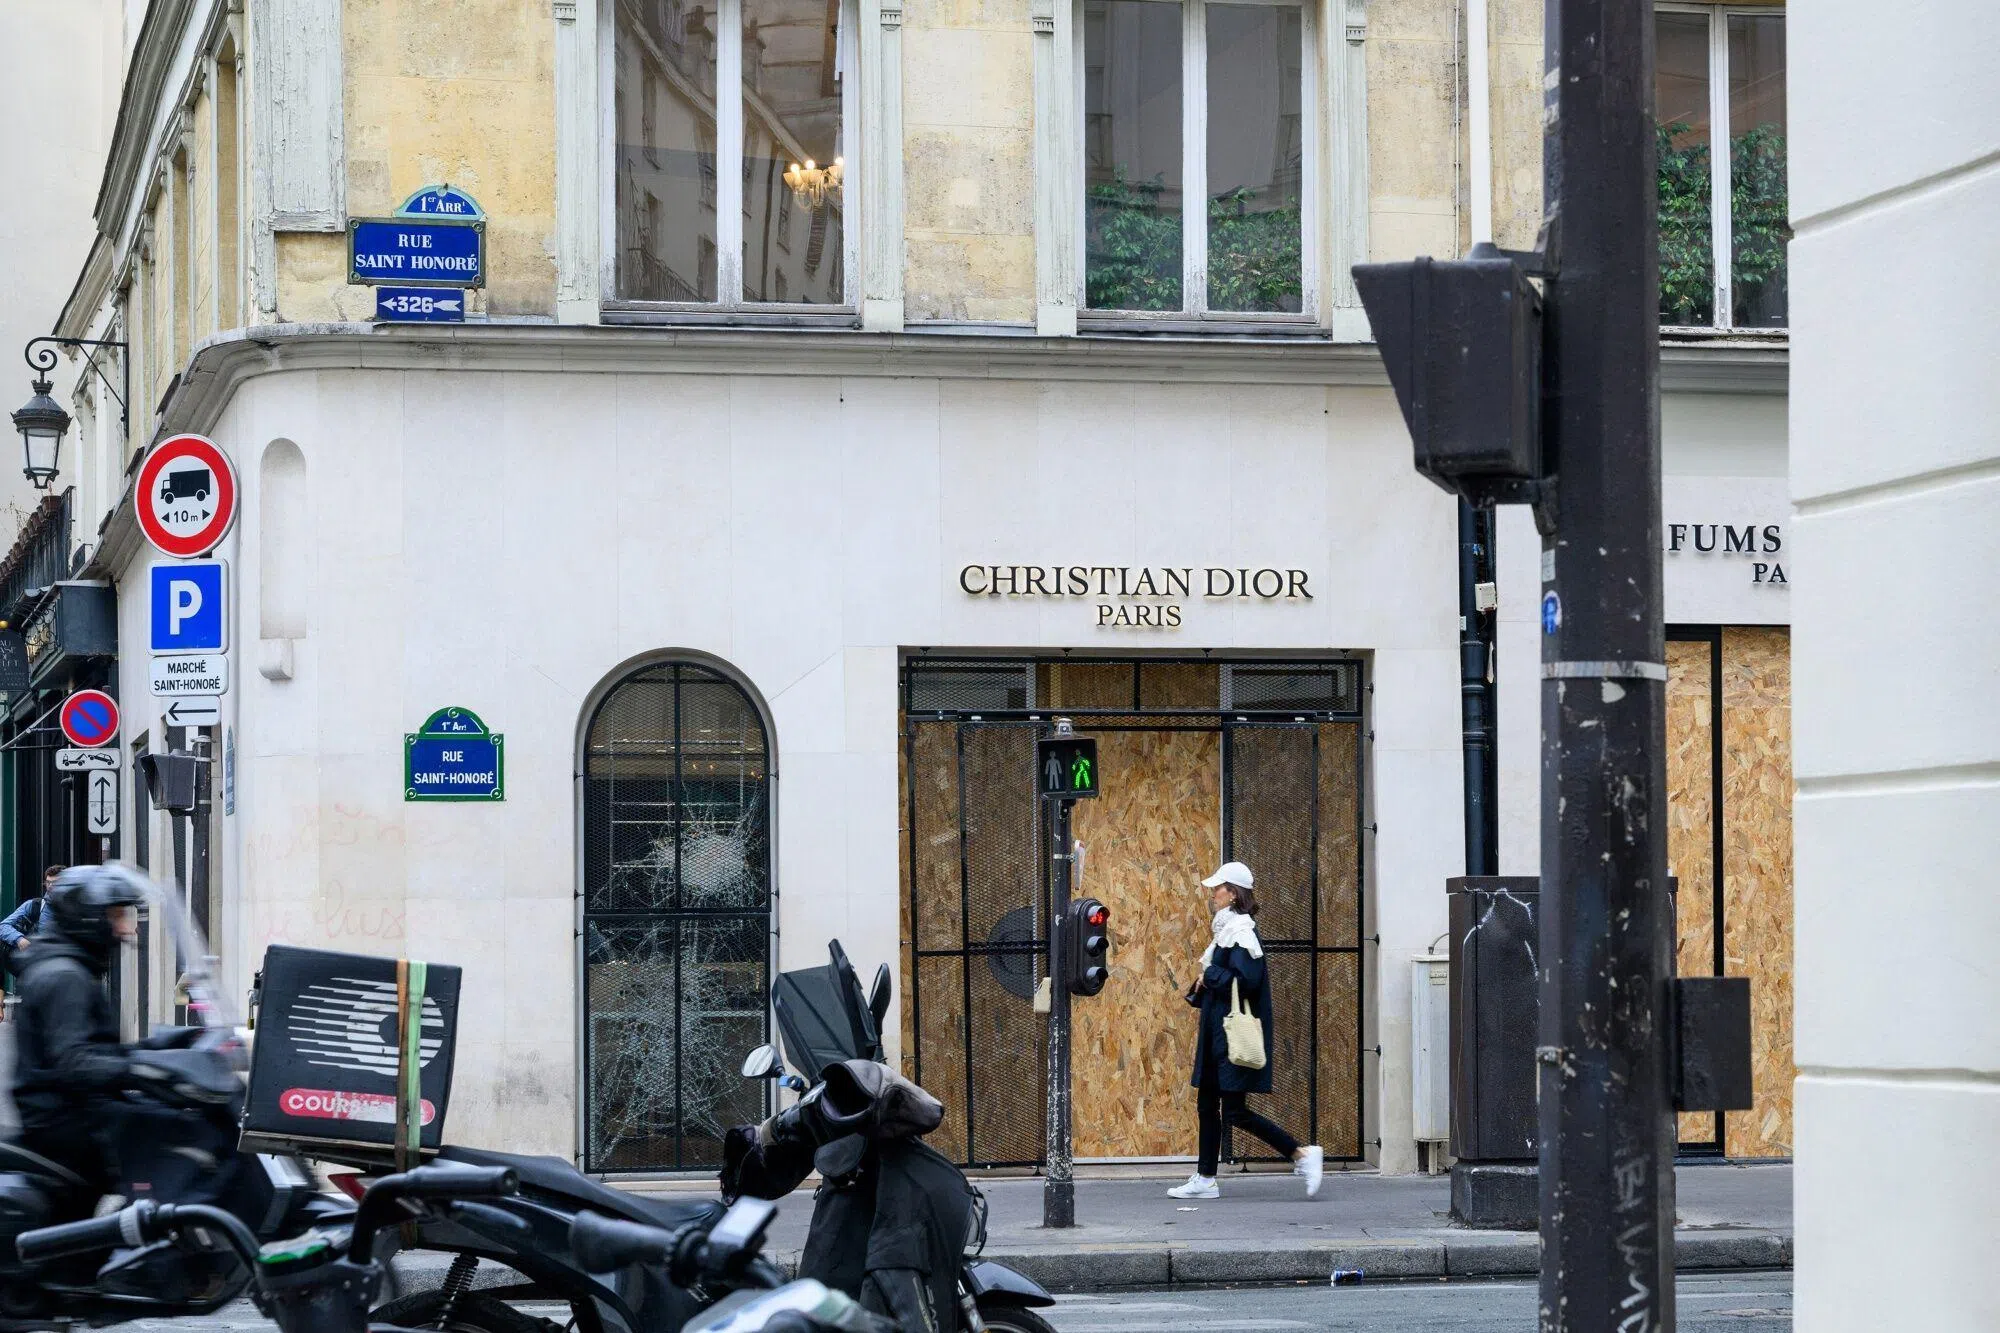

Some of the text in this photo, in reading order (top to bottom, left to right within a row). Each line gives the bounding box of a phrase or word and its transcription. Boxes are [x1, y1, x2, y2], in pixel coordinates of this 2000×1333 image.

[398, 233, 433, 249] RUE
[355, 253, 478, 271] SAINT HONORÉ
[397, 296, 434, 313] 326
[1663, 524, 1782, 553] FUMS
[959, 565, 1314, 599] CHRISTIAN DIOR
[169, 579, 203, 636] P
[1096, 604, 1182, 627] PARIS
[167, 660, 207, 674] MARCHÉ
[154, 676, 221, 691] SAINT-HONORÉ
[442, 751, 464, 762] RUE
[414, 771, 494, 784] SAINT-HONORÉ
